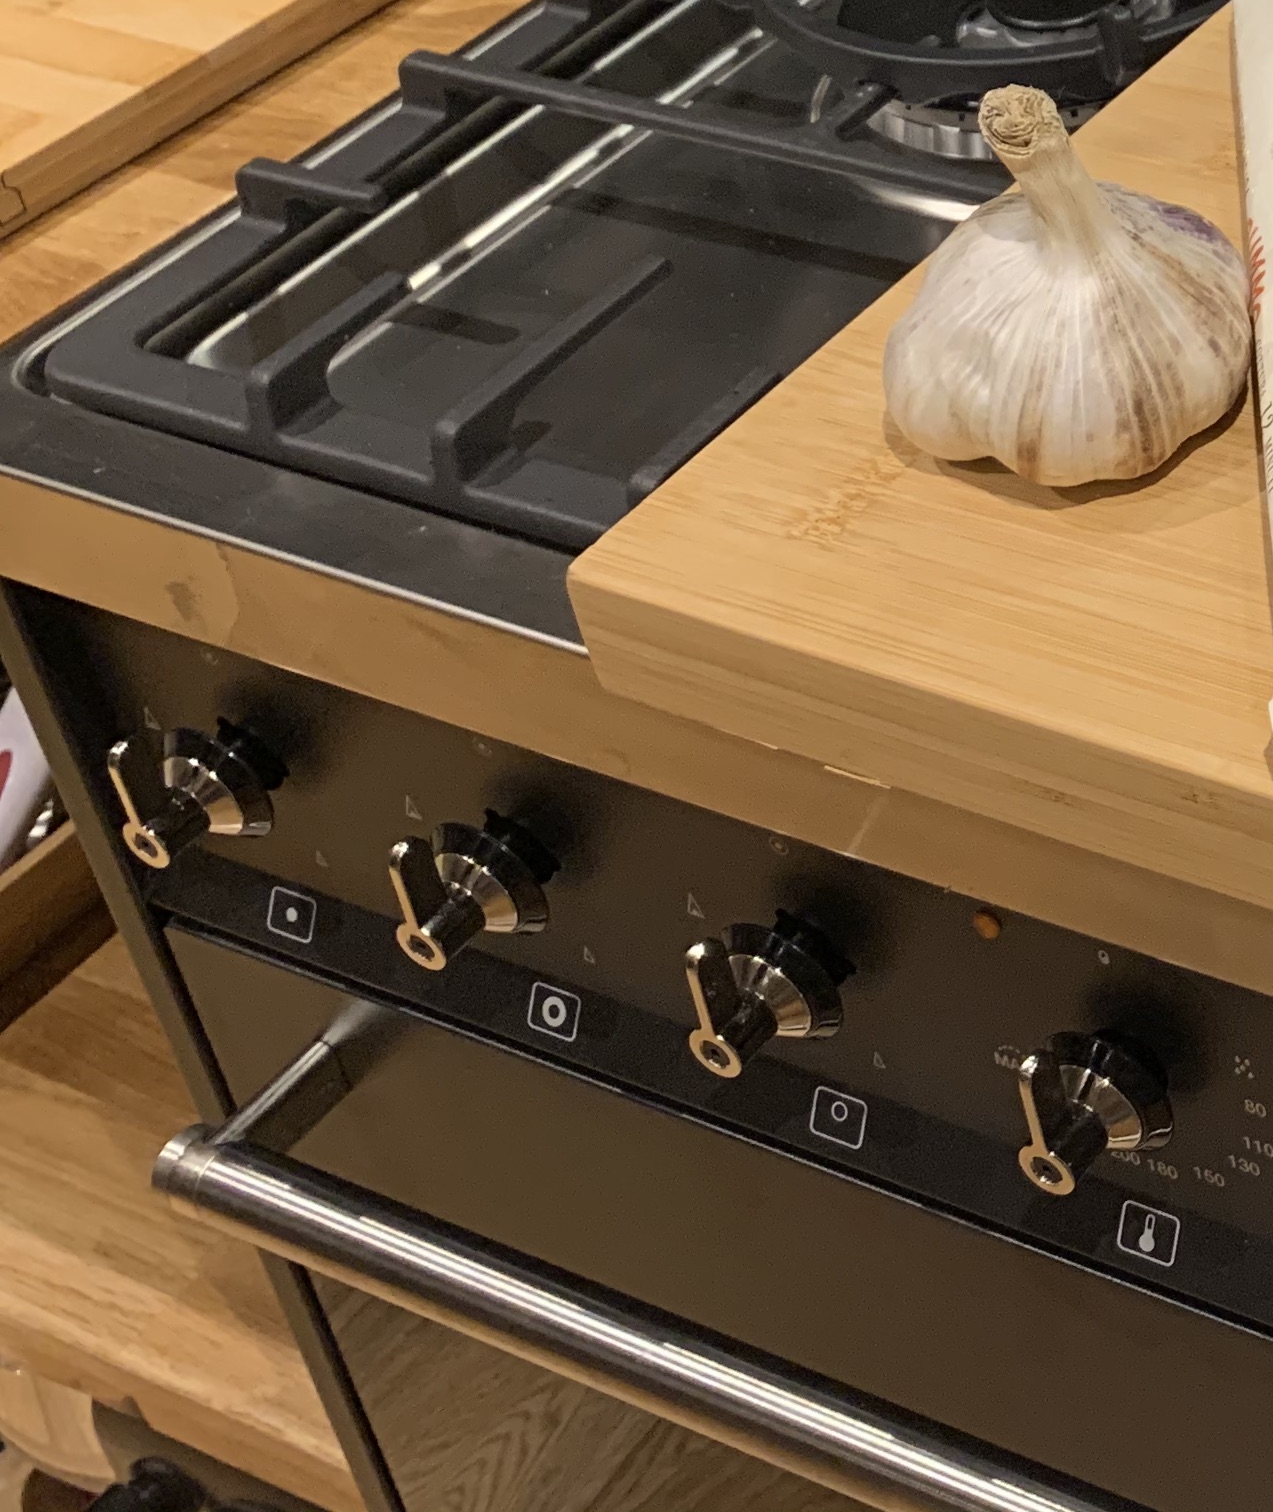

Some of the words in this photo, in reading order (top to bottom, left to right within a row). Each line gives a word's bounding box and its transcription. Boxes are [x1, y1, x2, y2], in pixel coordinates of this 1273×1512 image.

[993, 1051, 1021, 1071] MA
[1243, 1098, 1267, 1118] 80
[1146, 1159, 1179, 1180] 180
[1227, 1154, 1260, 1176] 130
